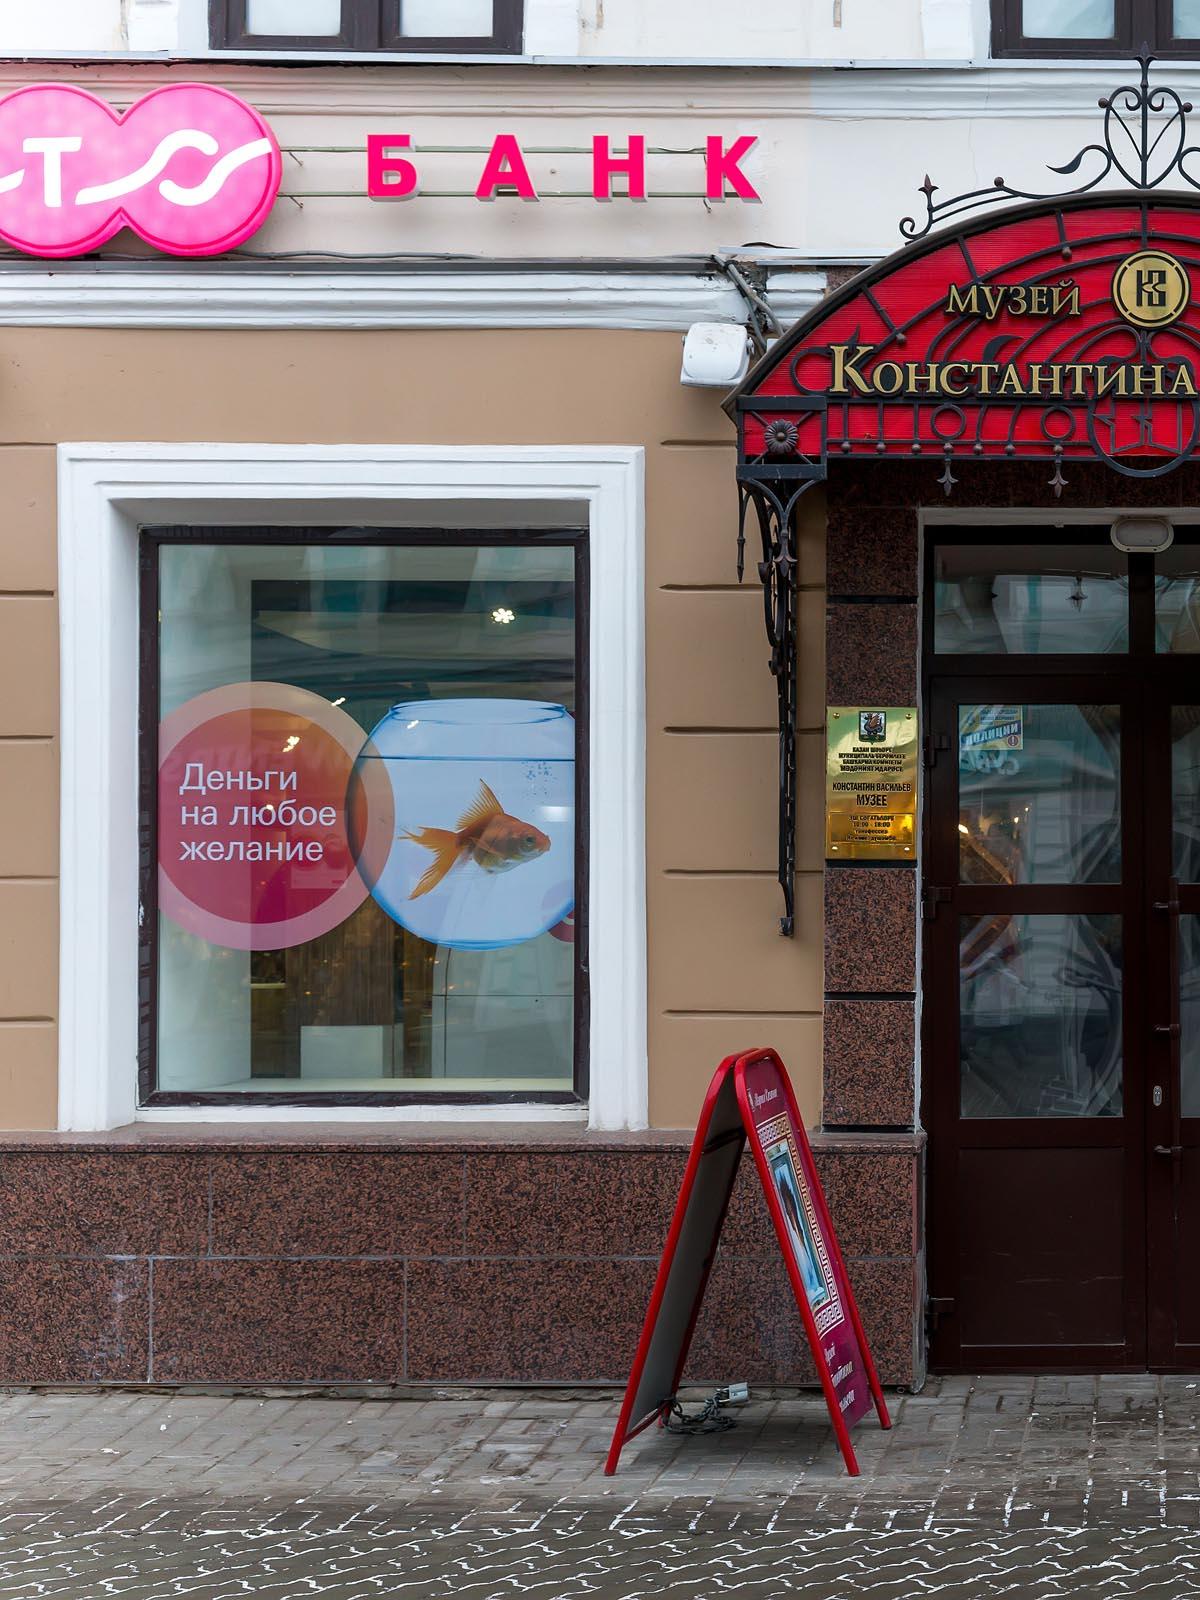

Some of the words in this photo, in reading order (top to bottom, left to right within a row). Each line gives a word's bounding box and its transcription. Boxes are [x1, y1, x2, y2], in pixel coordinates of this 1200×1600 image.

[366, 134, 761, 202] БАНК
[945, 280, 1081, 320] МУЗЕЙ
[179, 762, 297, 796] Деньги
[832, 782, 875, 791] КОНСТАНТИН
[876, 783, 911, 792] ВАСИЛЬЕВ
[181, 805, 218, 826] на
[229, 798, 337, 826] любое
[856, 794, 887, 806] МУЗЕЕ
[178, 841, 324, 861] желание
